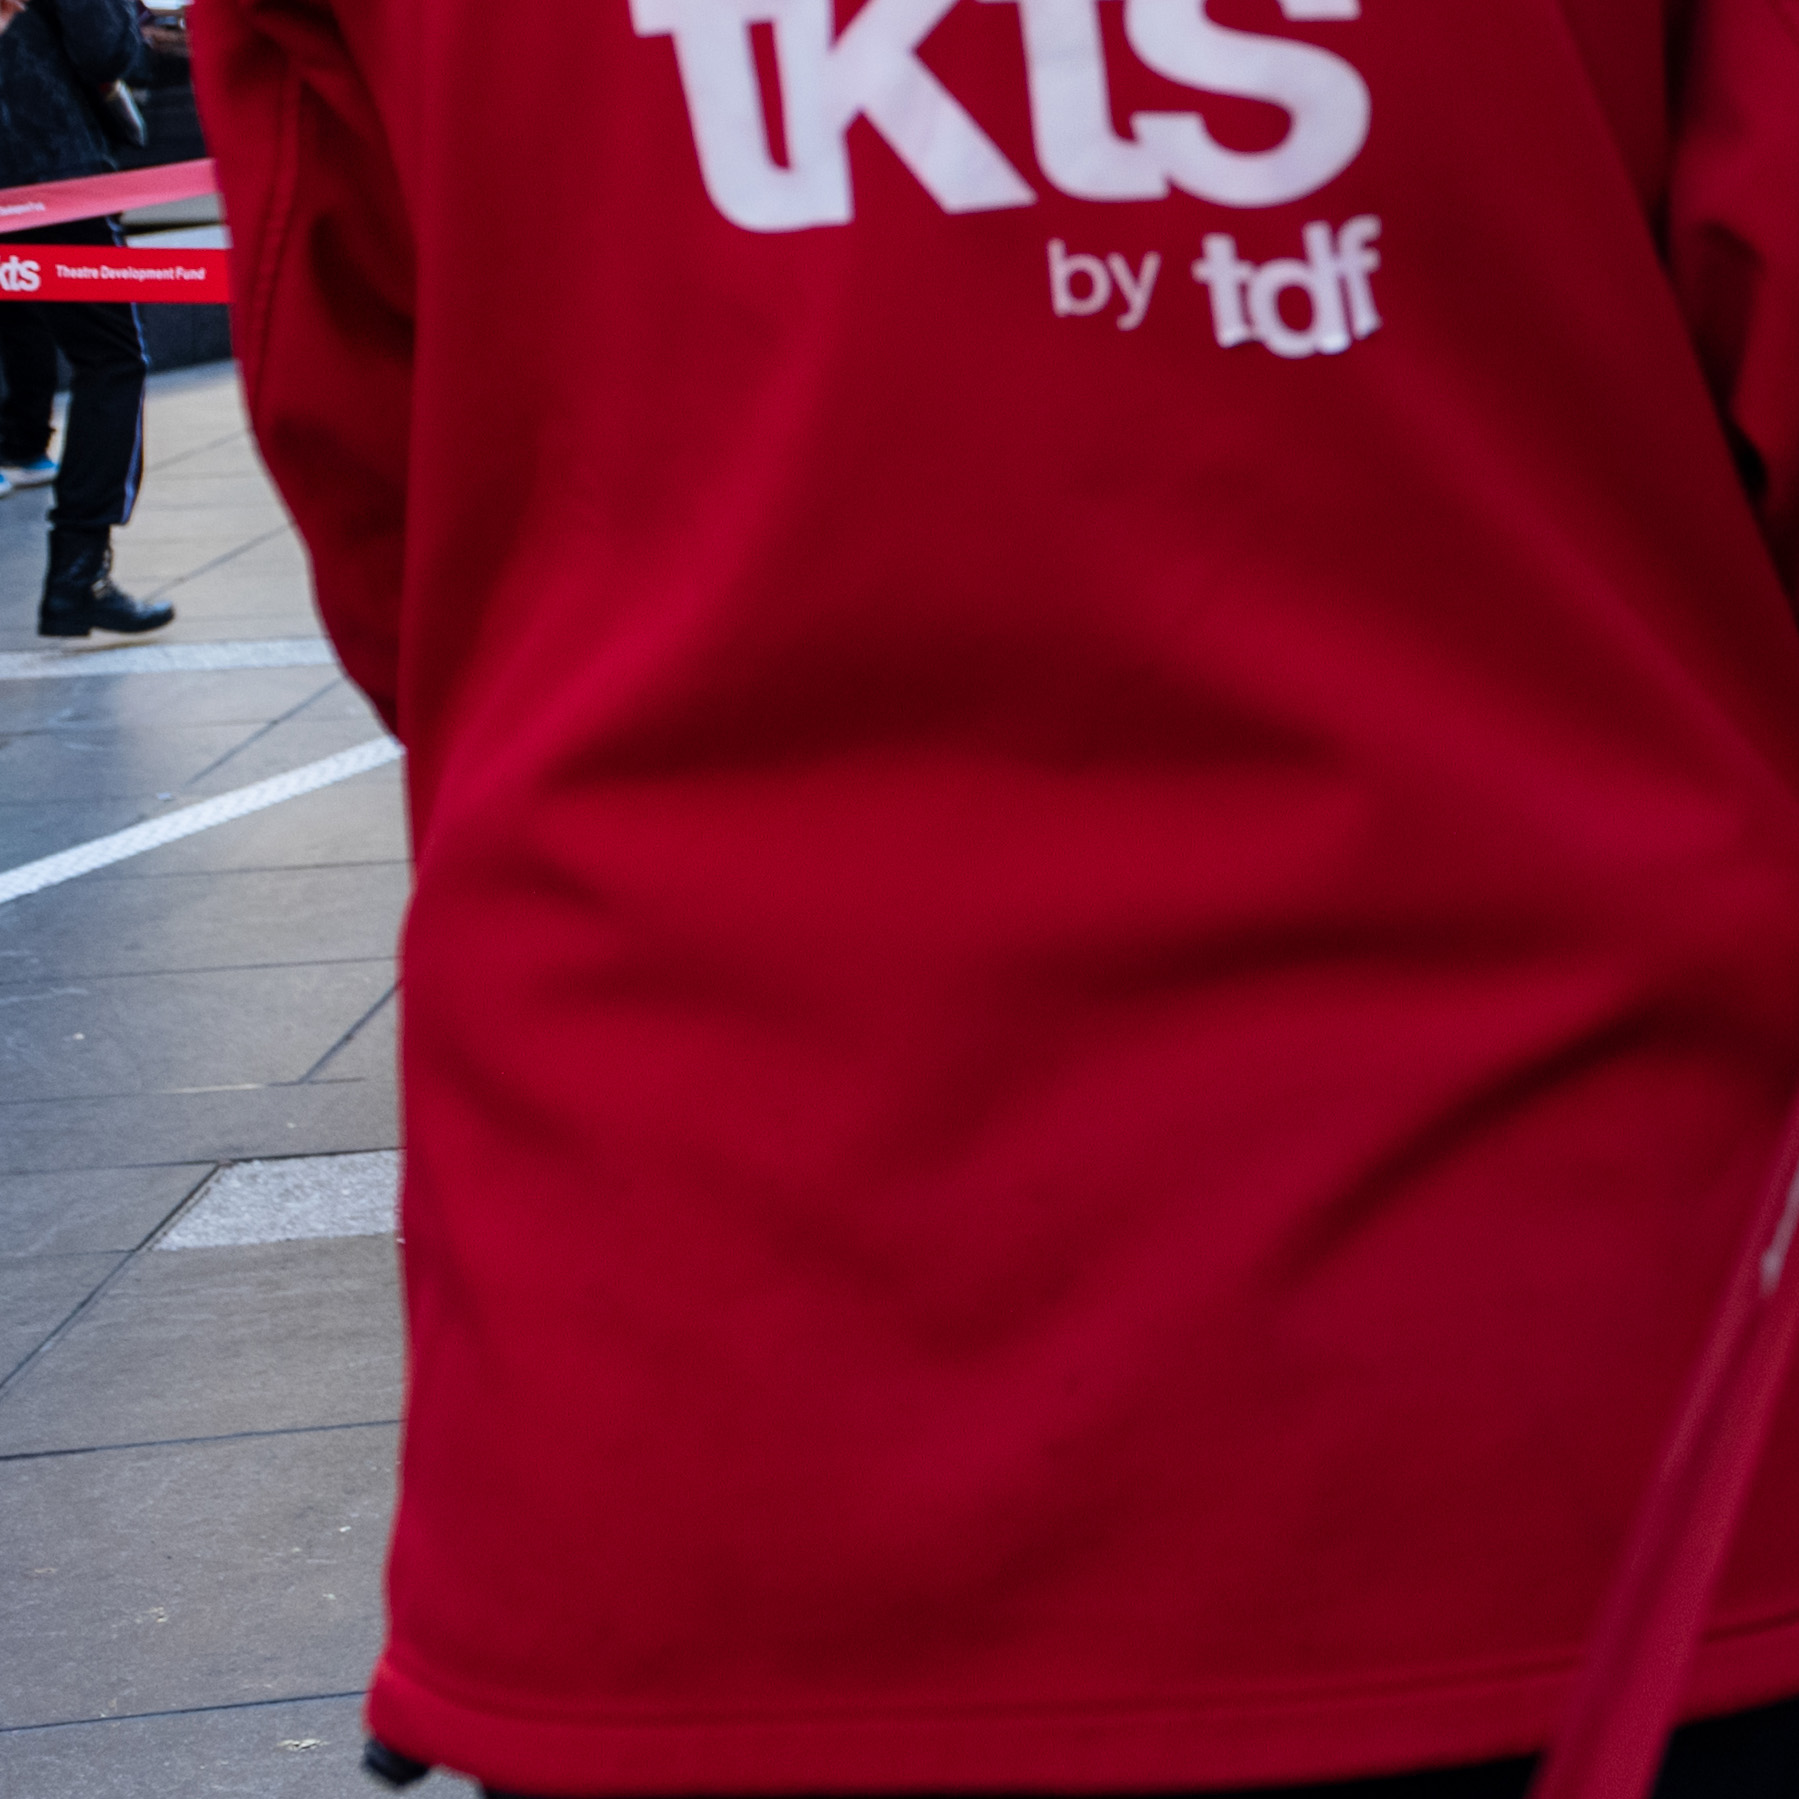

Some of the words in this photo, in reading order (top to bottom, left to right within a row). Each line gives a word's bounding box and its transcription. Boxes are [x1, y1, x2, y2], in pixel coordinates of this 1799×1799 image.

[56, 264, 99, 280] Theatre
[99, 264, 175, 282] Development
[175, 266, 206, 281] Fund
[1046, 237, 1161, 331] by
[1190, 214, 1381, 360] tdf
